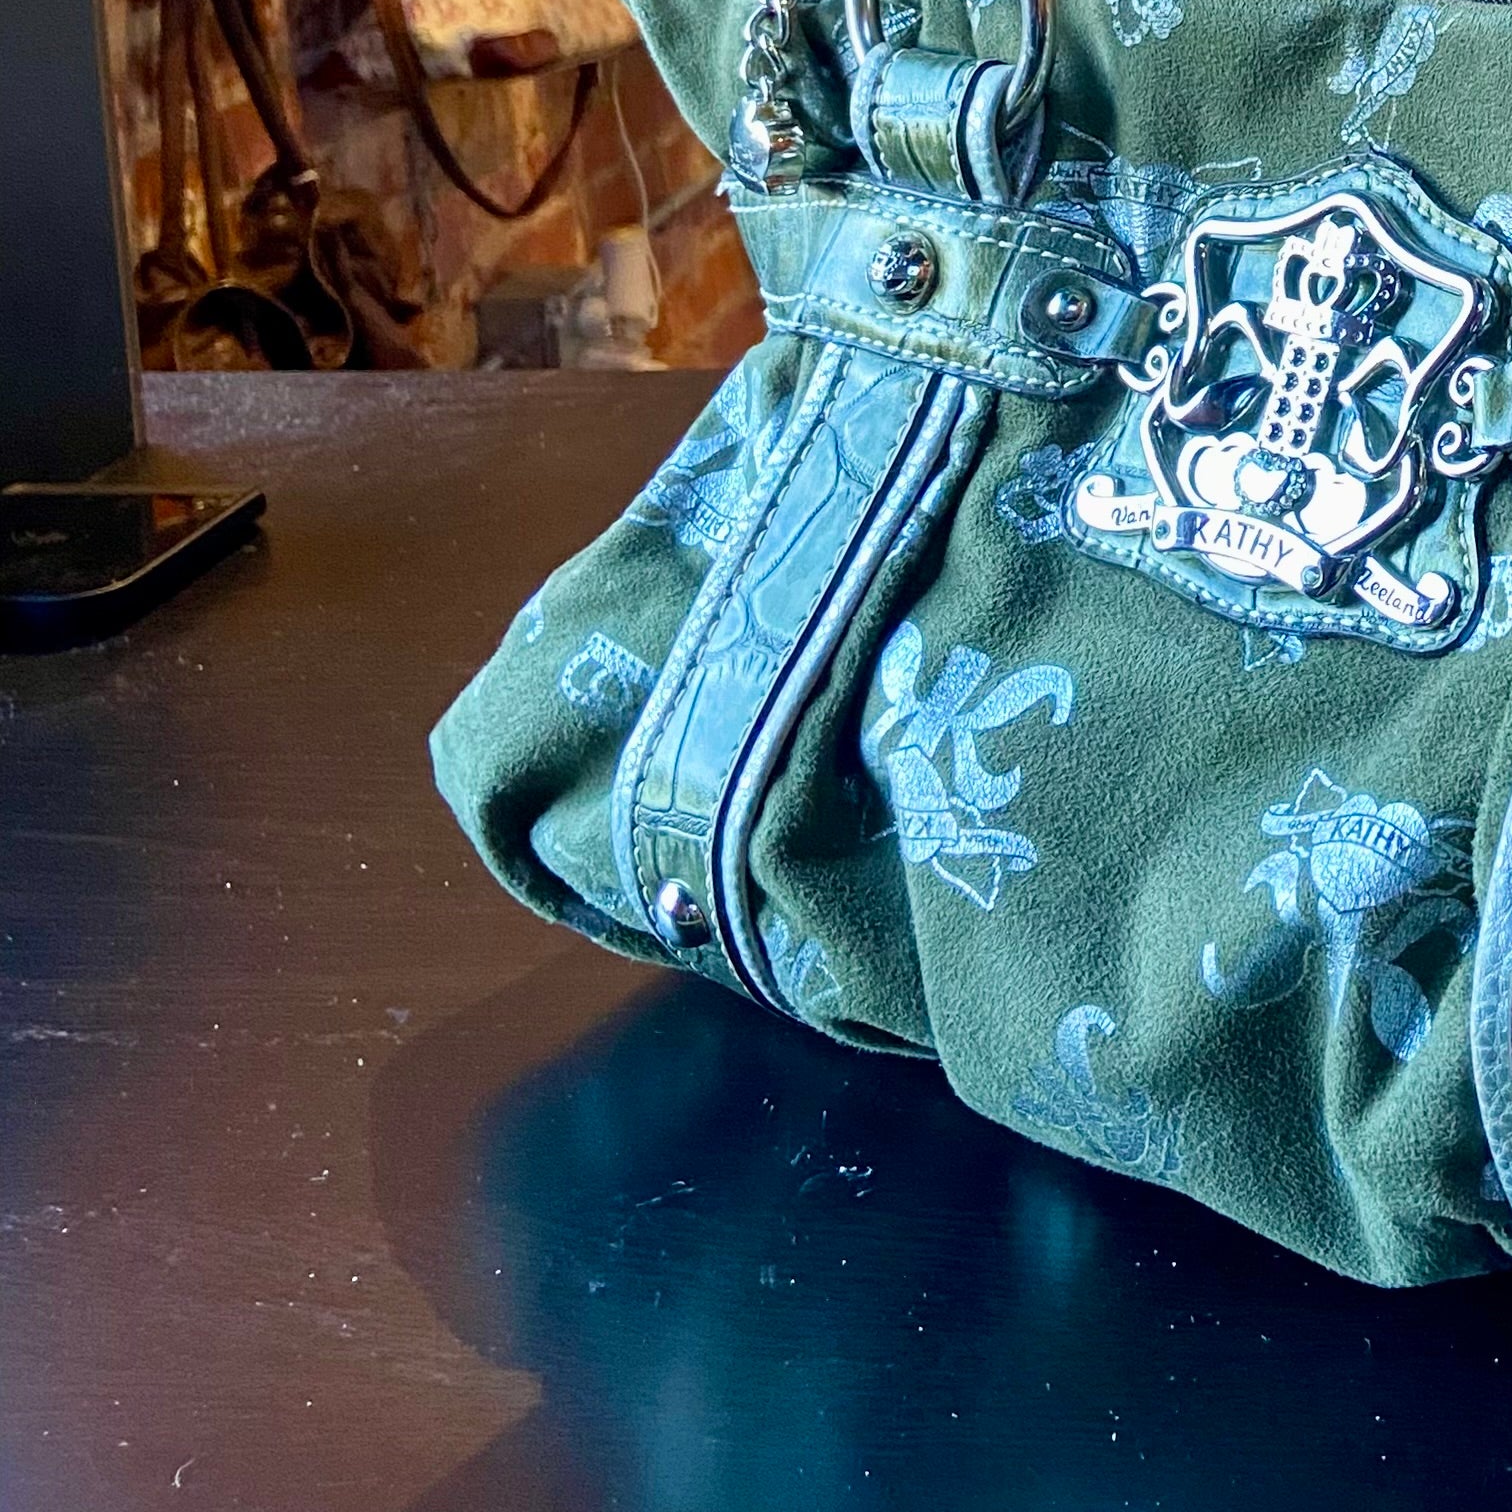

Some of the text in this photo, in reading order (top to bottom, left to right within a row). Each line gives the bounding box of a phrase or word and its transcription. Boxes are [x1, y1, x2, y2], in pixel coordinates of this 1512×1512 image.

[1111, 505, 1432, 624] Van KATHY Zeeland
[1329, 815, 1413, 861] KATHY
